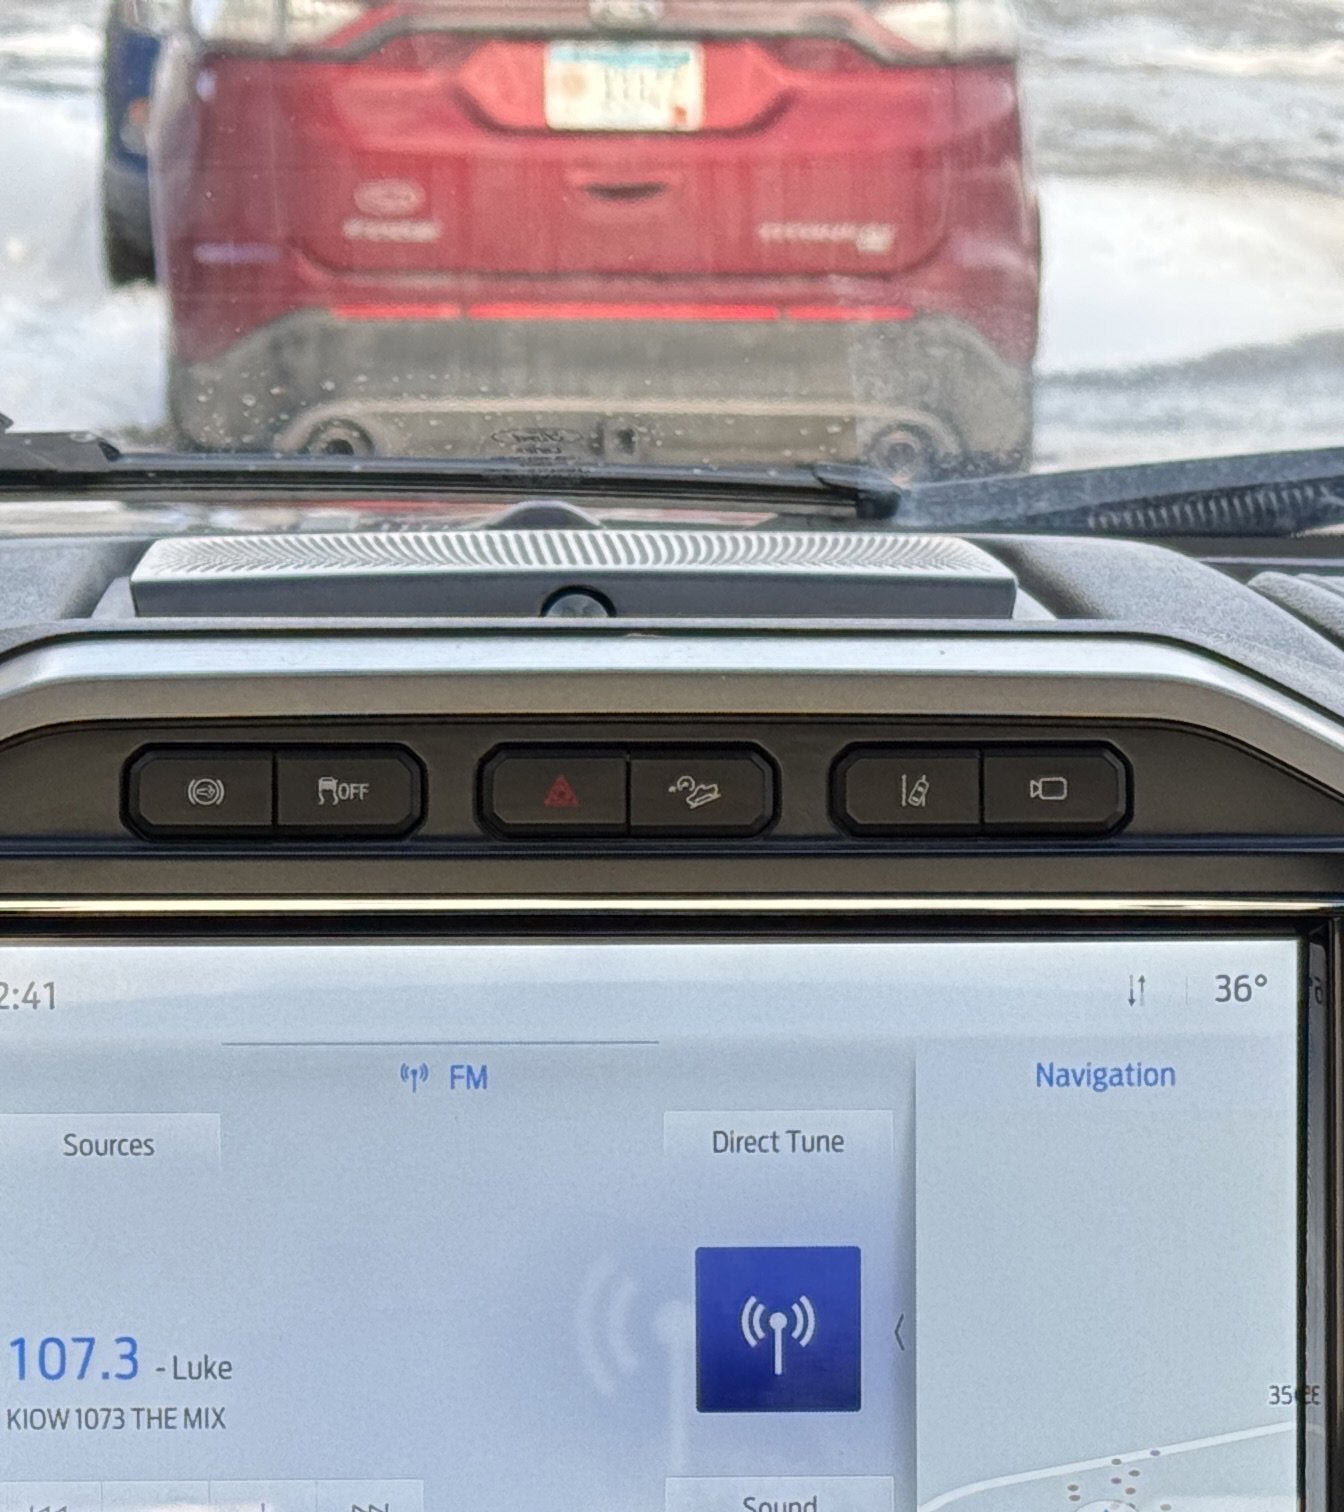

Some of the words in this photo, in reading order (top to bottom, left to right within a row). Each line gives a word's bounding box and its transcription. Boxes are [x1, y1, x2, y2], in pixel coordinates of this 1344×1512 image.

[337, 782, 368, 800] OFF
[1215, 973, 1268, 1003] 36°
[450, 1064, 488, 1090] FM
[1036, 1062, 1176, 1093] Navigation
[63, 1133, 155, 1157] Sources
[712, 1130, 780, 1154] Direct
[785, 1129, 845, 1154] Tune
[10, 1336, 139, 1381] 107.3
[173, 1354, 233, 1381] Luke
[6, 1408, 71, 1431] KIOW
[75, 1407, 126, 1430] 1073
[130, 1407, 177, 1430] THE
[183, 1407, 226, 1429] MIX
